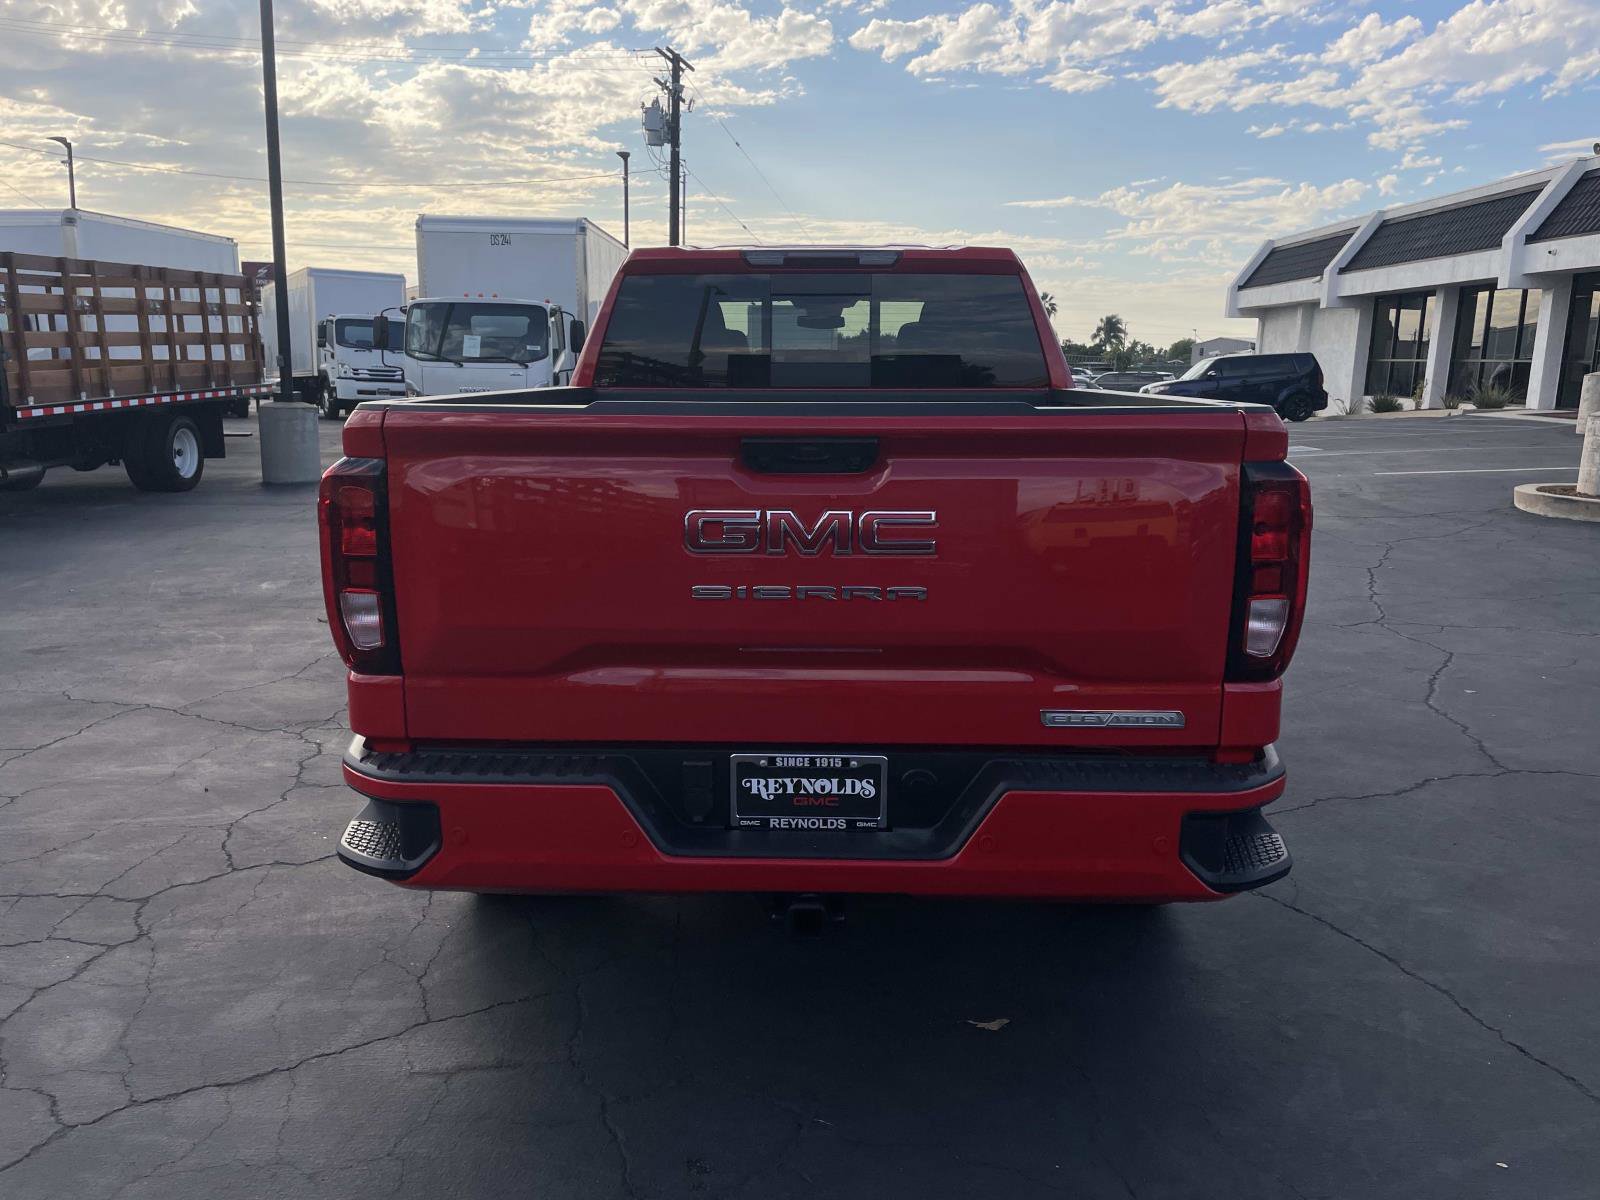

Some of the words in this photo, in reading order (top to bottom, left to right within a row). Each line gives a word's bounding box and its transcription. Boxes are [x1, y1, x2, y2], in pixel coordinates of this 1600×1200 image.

[684, 509, 937, 555] GMC
[691, 585, 928, 601] SIERRA
[1051, 713, 1178, 725] ELEVATION
[775, 757, 811, 767] SINCE
[815, 758, 842, 768] 1915
[741, 778, 876, 801] REYNOLDS
[792, 797, 840, 807] GMC
[769, 818, 847, 830] REYNOLDS
